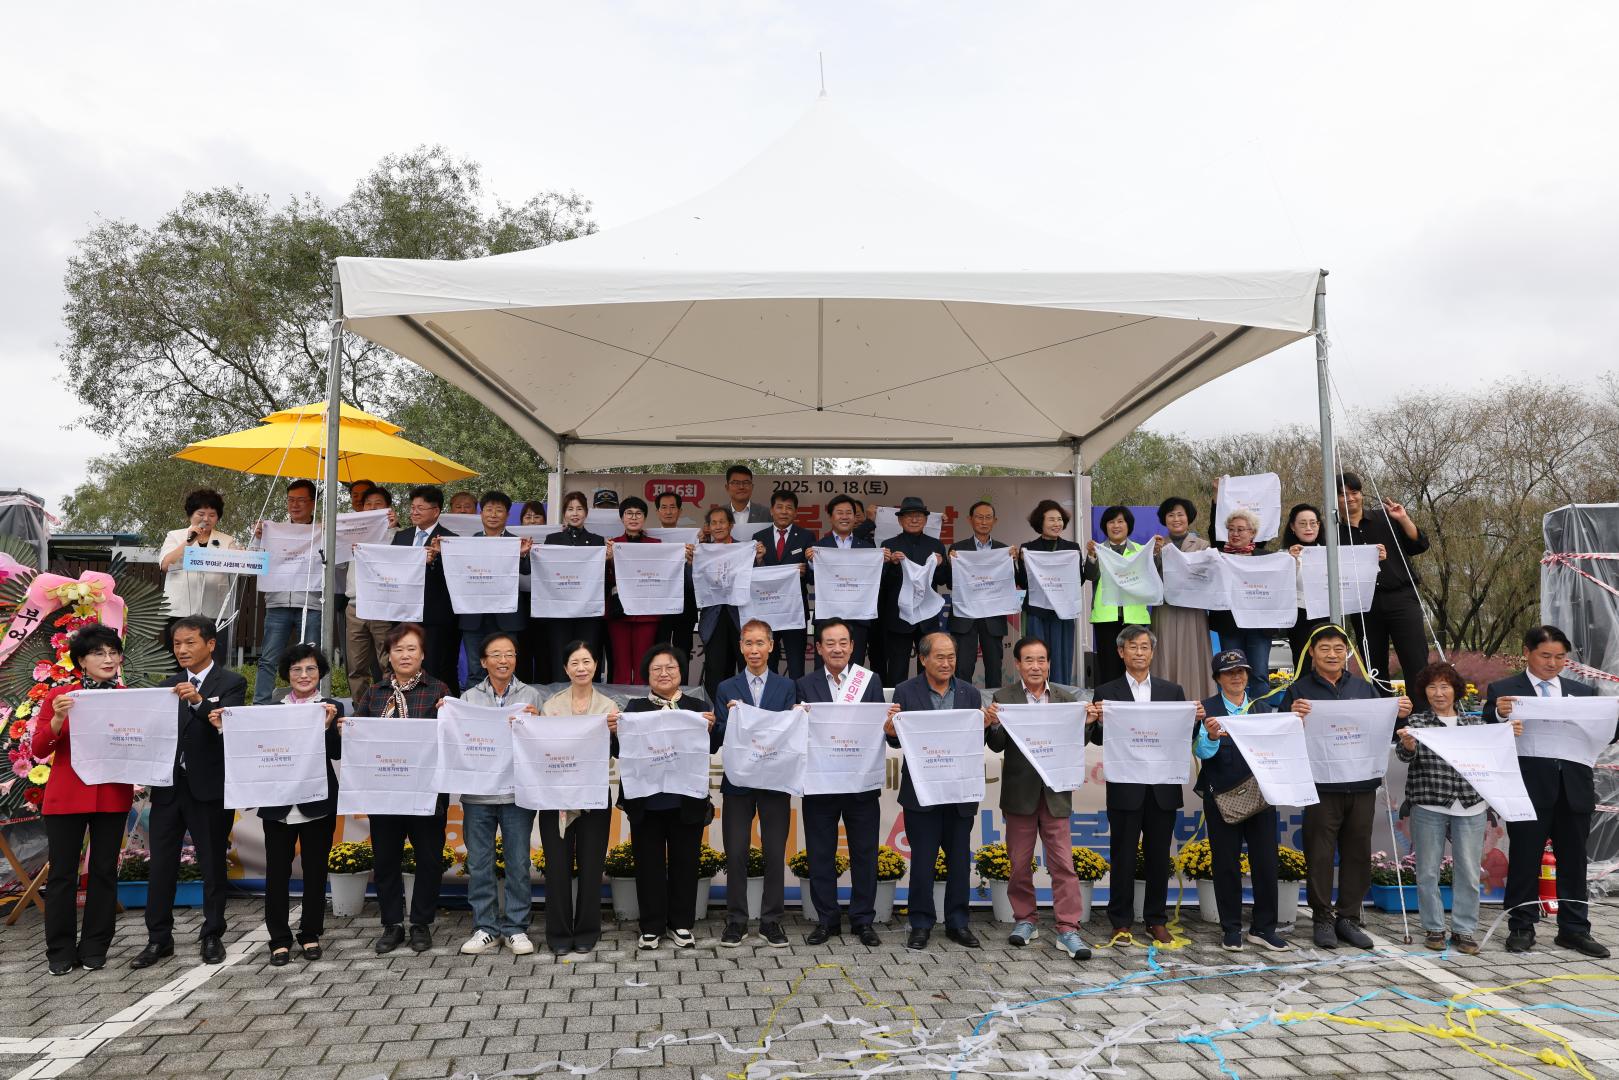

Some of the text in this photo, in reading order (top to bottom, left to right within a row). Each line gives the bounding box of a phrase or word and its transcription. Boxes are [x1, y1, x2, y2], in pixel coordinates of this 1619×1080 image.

[652, 483, 697, 498] 제26회
[772, 480, 889, 496] 2025. 10. 18.(토)
[190, 559, 204, 567] 2025
